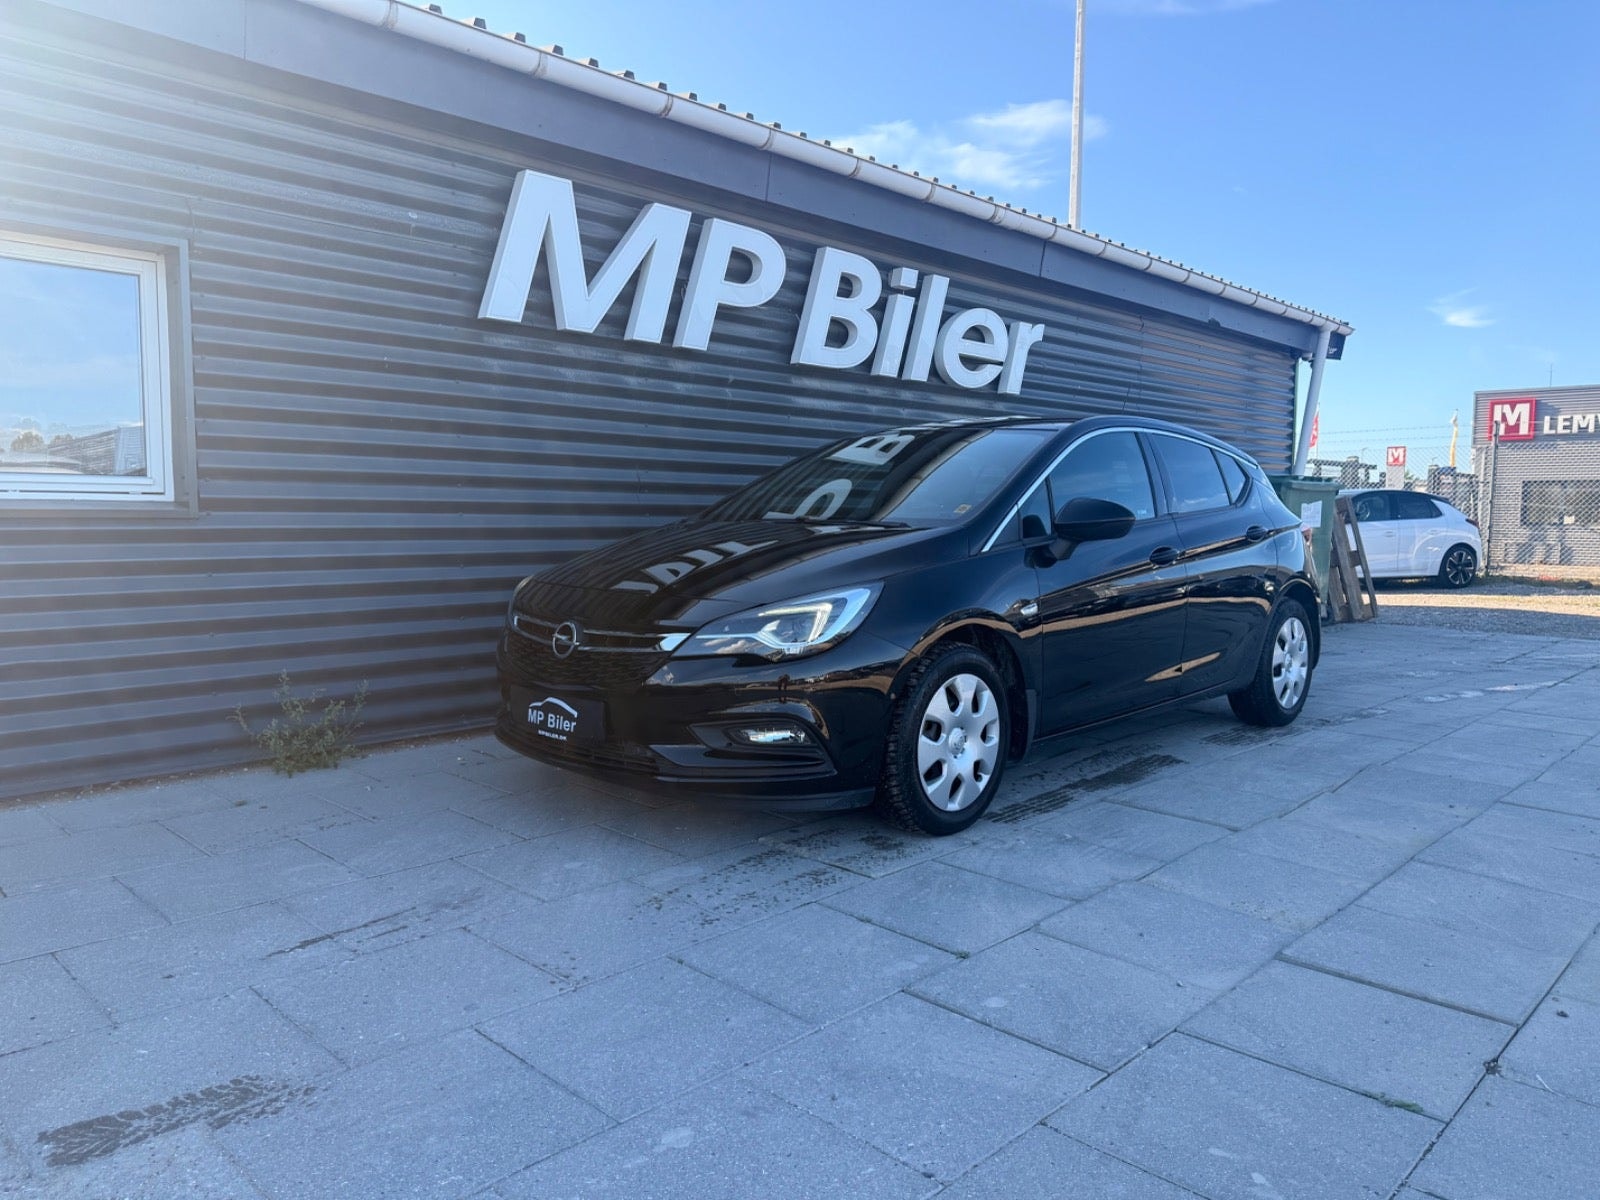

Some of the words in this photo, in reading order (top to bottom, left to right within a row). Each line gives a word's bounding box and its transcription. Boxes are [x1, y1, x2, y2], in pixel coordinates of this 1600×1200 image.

[478, 169, 786, 351] MP
[790, 246, 1044, 395] Biler
[1543, 413, 1600, 434] LEM
[528, 708, 544, 724] MP
[548, 713, 576, 732] Biler
